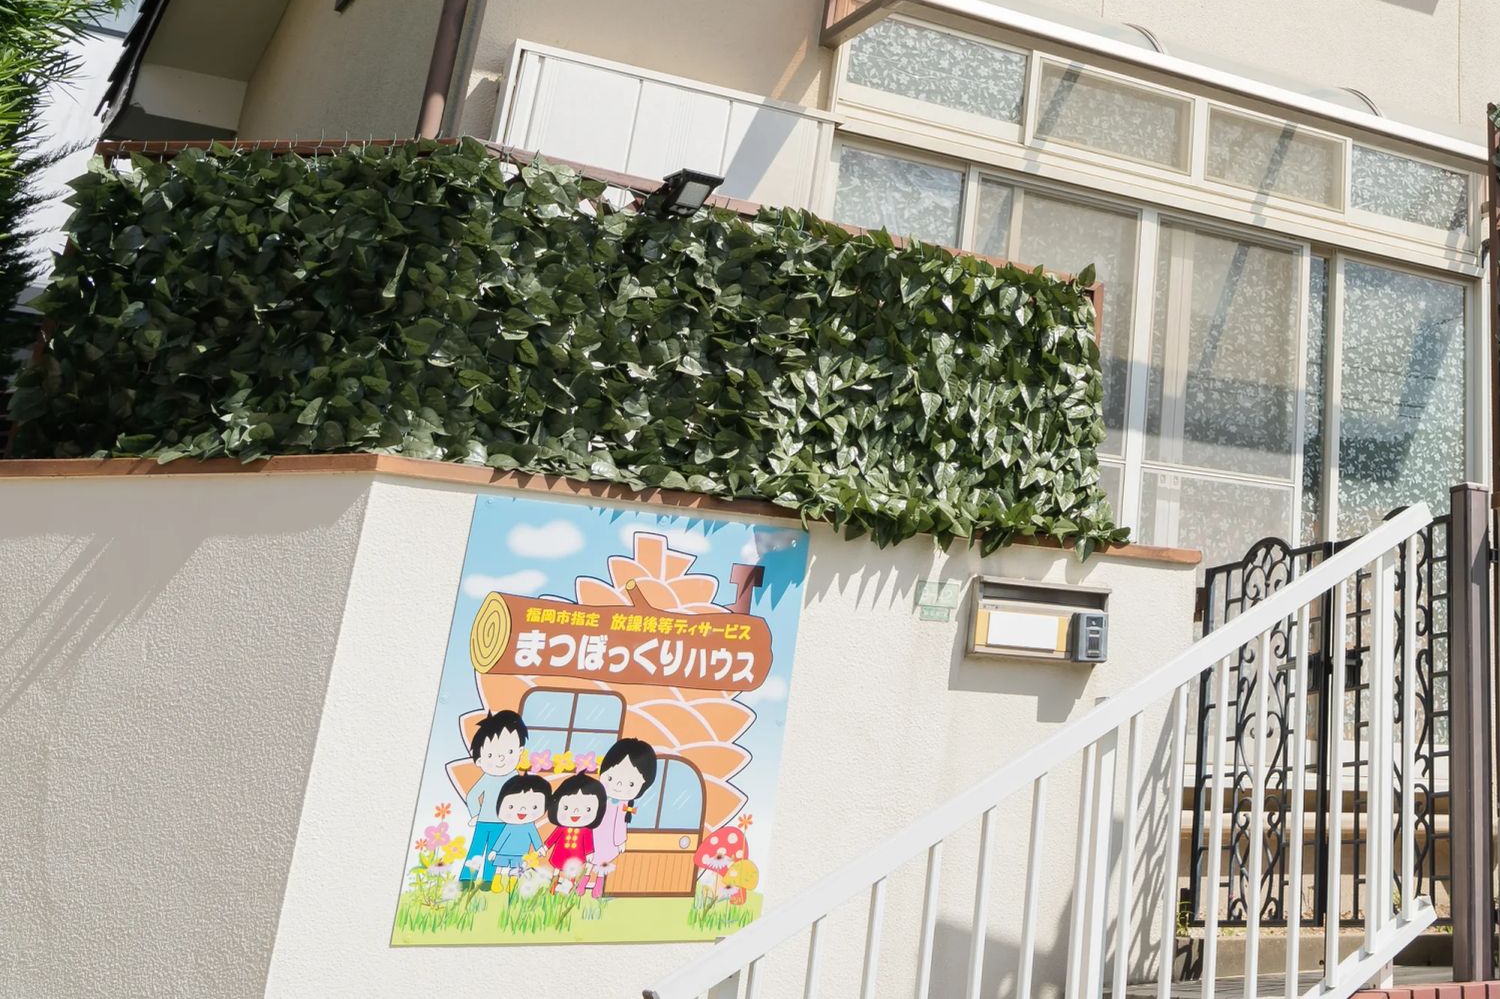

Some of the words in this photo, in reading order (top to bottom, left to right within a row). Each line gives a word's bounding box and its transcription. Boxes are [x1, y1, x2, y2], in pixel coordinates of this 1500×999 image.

[526, 607, 600, 627] 福岡市指定
[514, 629, 755, 683] まつぼっくりハウス
